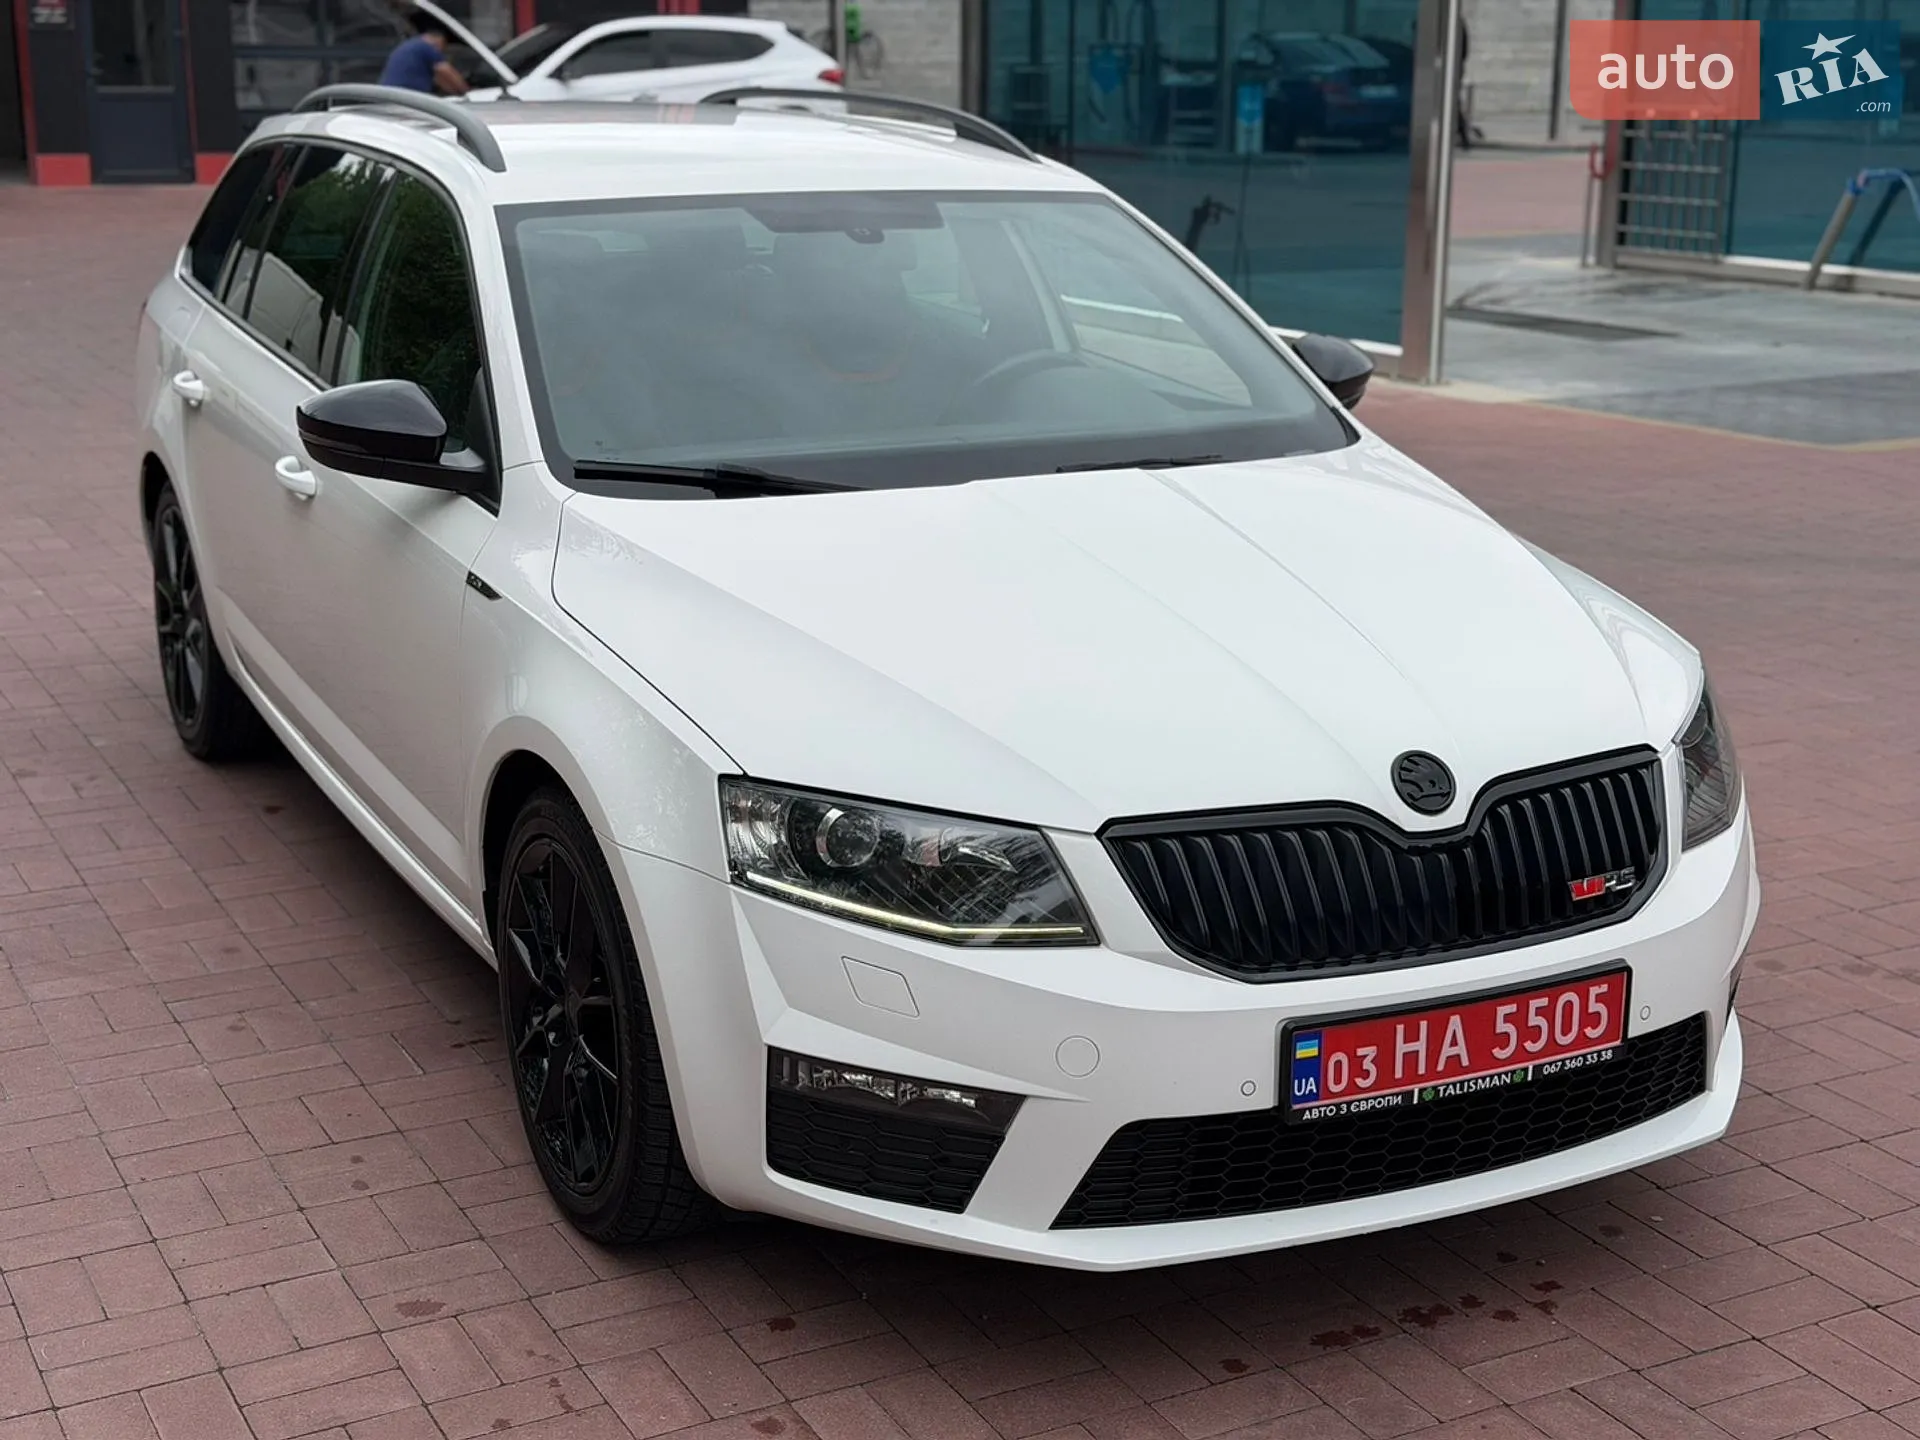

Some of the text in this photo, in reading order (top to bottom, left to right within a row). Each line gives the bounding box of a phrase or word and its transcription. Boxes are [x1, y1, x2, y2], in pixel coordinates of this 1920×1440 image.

[1491, 983, 1609, 1060] 5505
[1542, 1062, 1561, 1076] 067
[1564, 1056, 1584, 1071] 360
[1586, 1052, 1599, 1066] 33
[1294, 1078, 1317, 1096] UA
[1437, 1073, 1511, 1098] TALISMAN
[1302, 1105, 1336, 1120] АВТО
[1350, 1094, 1403, 1113] ЄВРОПИ
